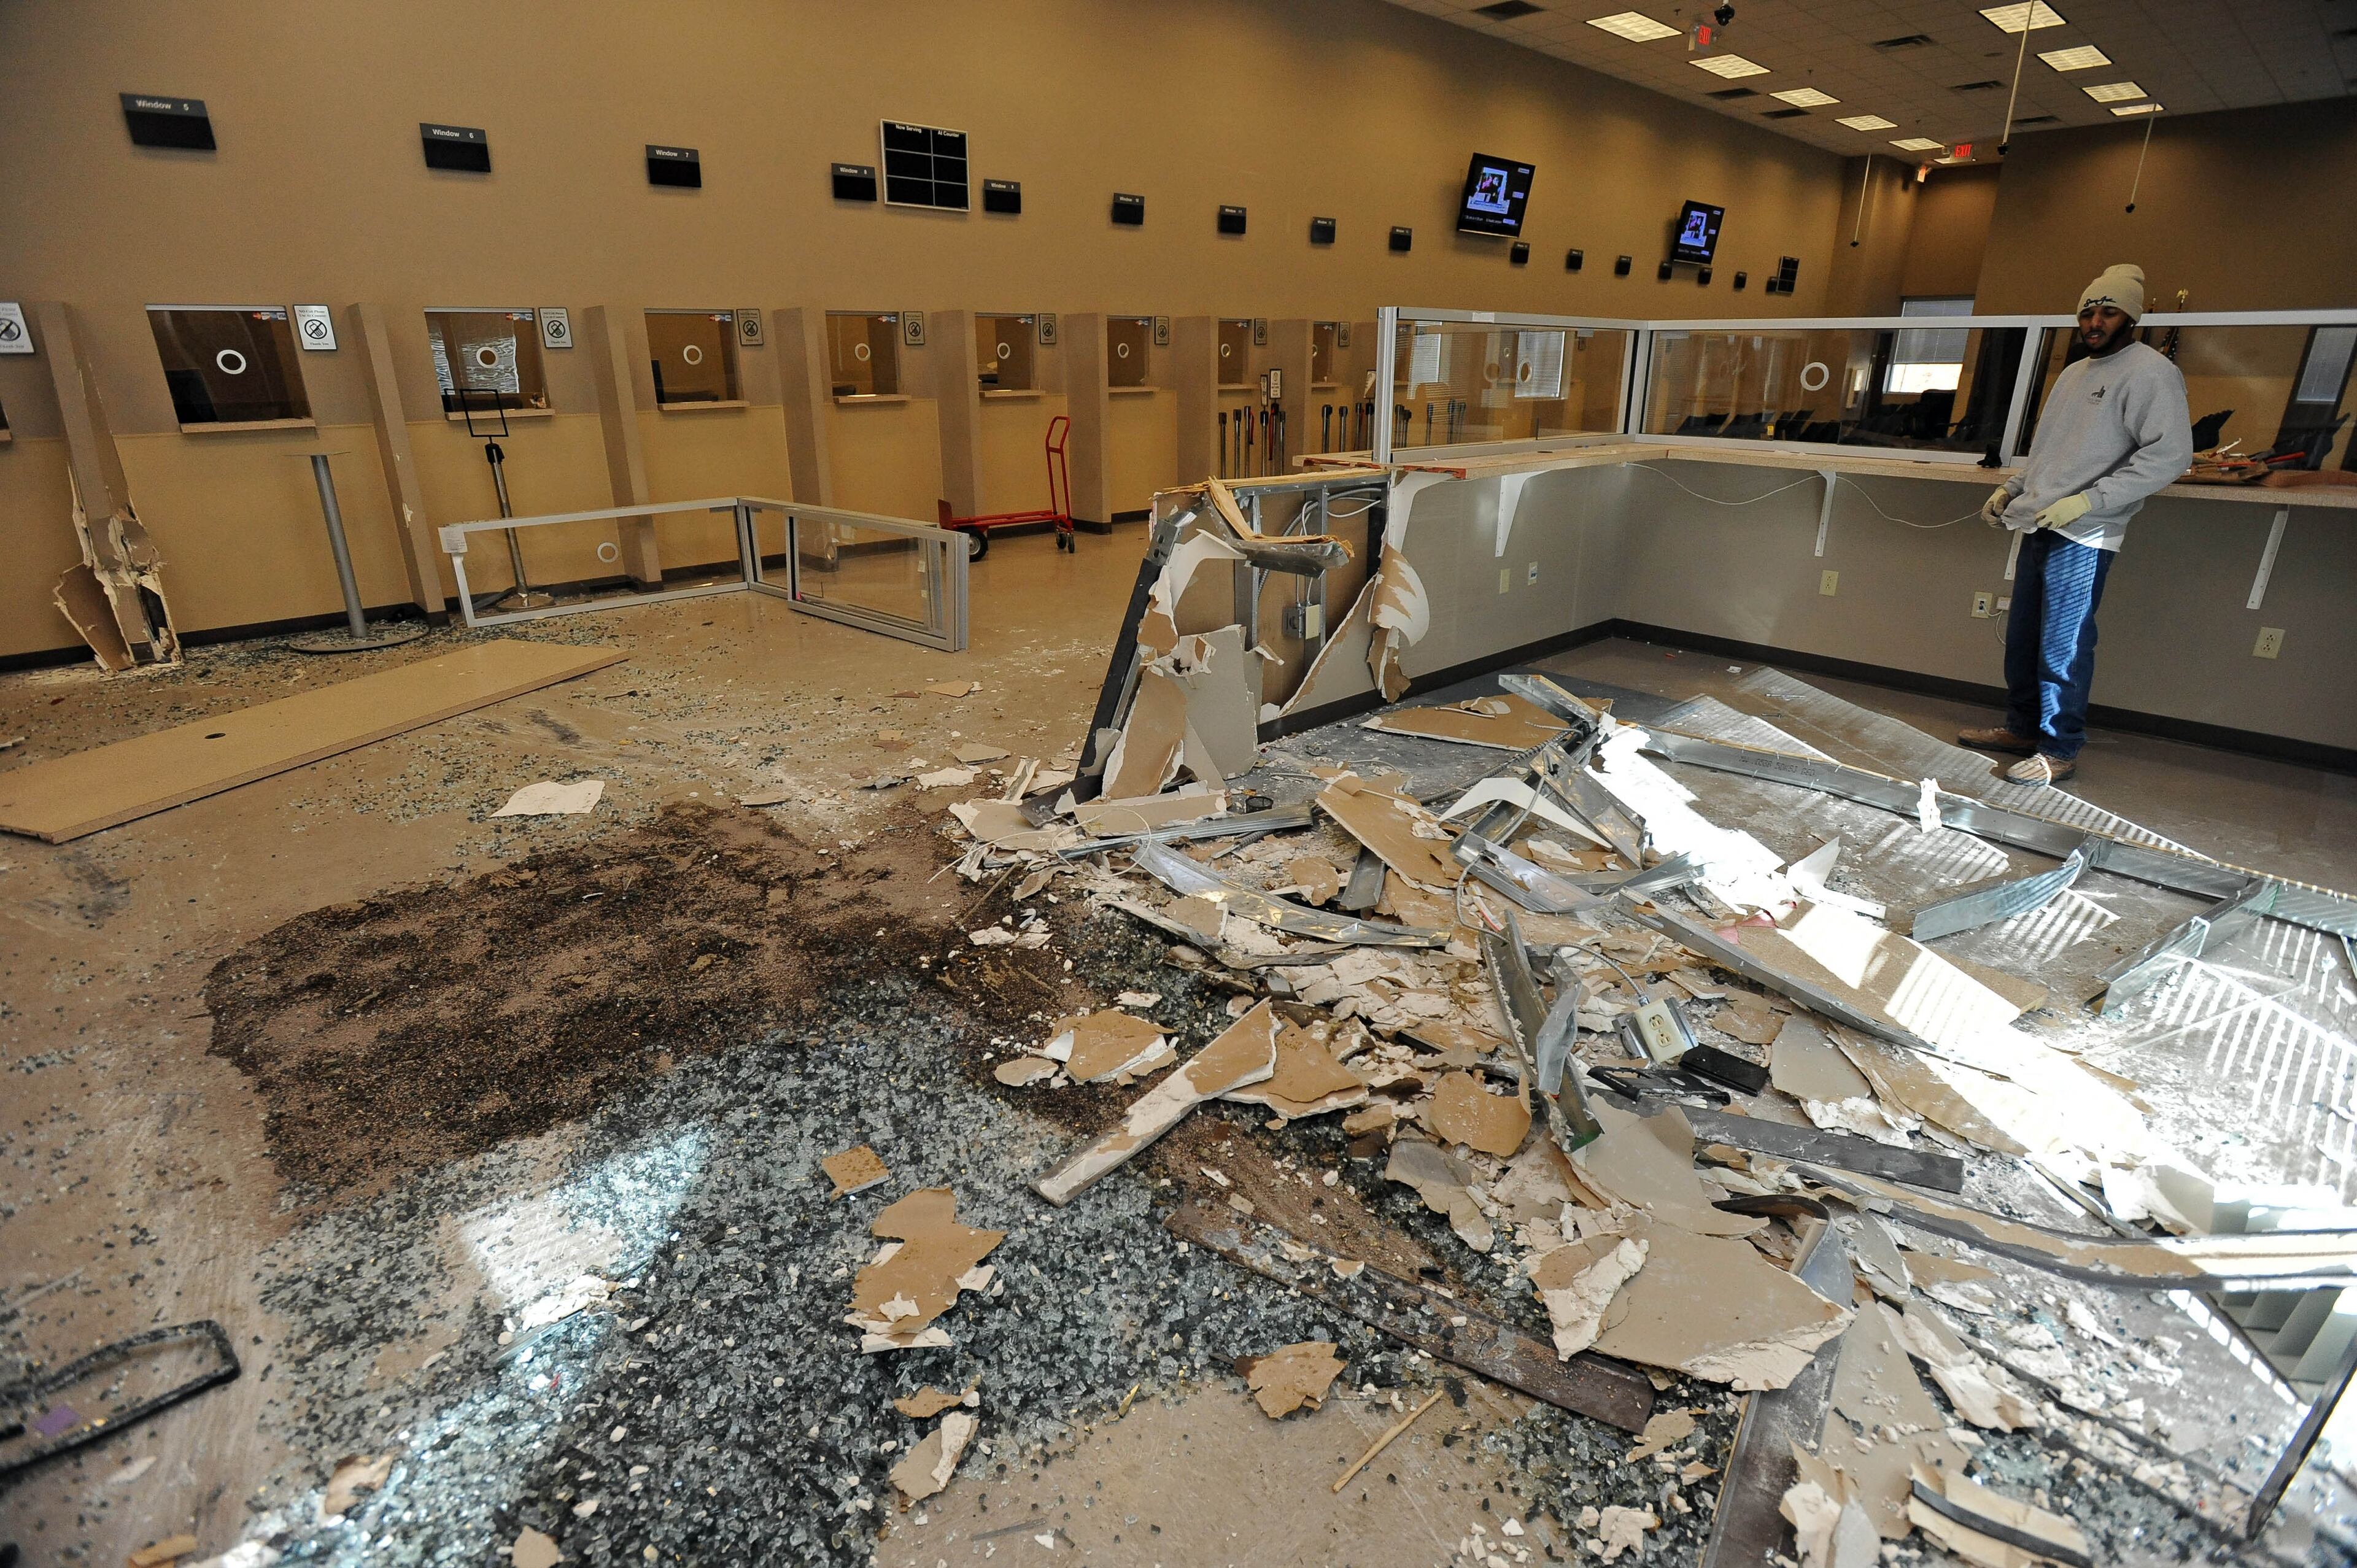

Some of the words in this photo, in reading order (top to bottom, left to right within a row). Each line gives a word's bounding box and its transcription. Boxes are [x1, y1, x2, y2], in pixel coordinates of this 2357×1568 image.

[1699, 25, 1711, 45] EXIT
[136, 99, 171, 110] Window
[1954, 144, 1972, 157] EXIT
